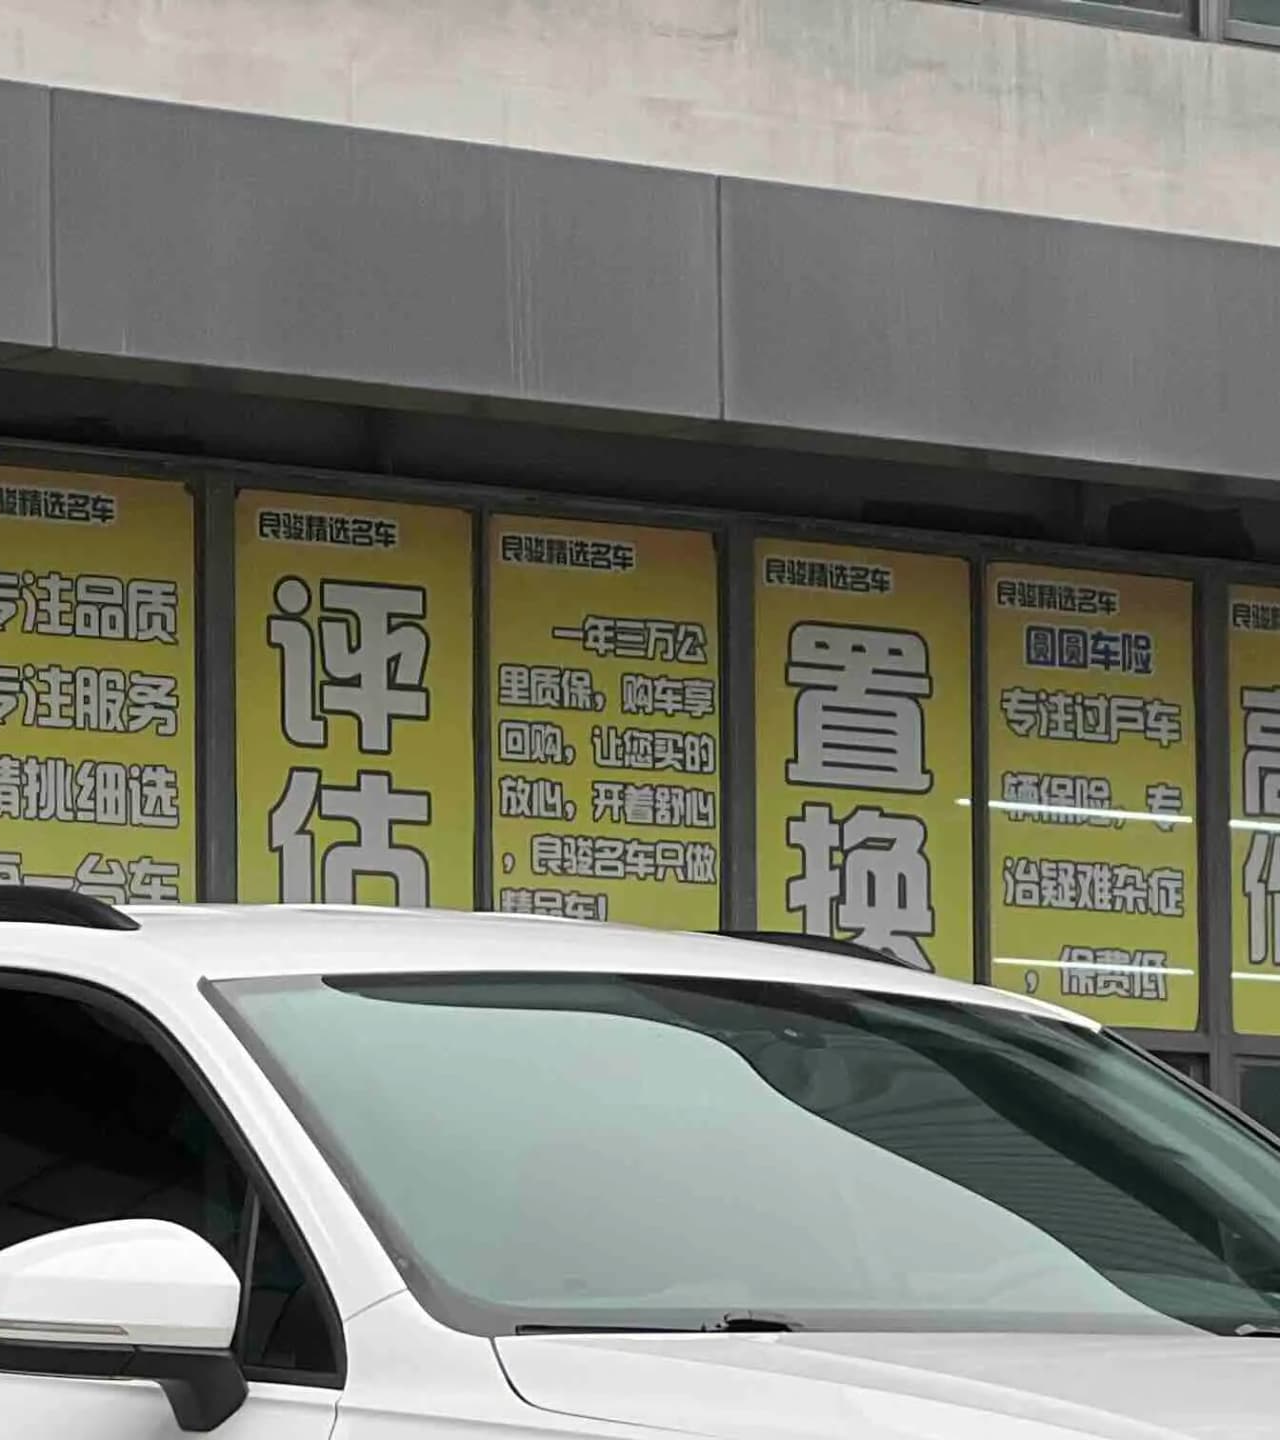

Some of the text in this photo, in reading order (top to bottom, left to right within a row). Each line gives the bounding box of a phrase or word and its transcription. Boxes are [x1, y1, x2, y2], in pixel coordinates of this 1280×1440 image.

[259, 511, 396, 547] 良骏精选名车
[502, 535, 633, 570] 良骏精选名车
[765, 558, 891, 593] 良骏精选名车
[997, 581, 1118, 614] 良骏精选名车
[552, 615, 708, 664] 一年三万公
[1026, 626, 1153, 674] 圆圆车险
[267, 574, 431, 907] 评估
[785, 620, 934, 973] 置换
[1003, 856, 1184, 918] 治疑难杂症
